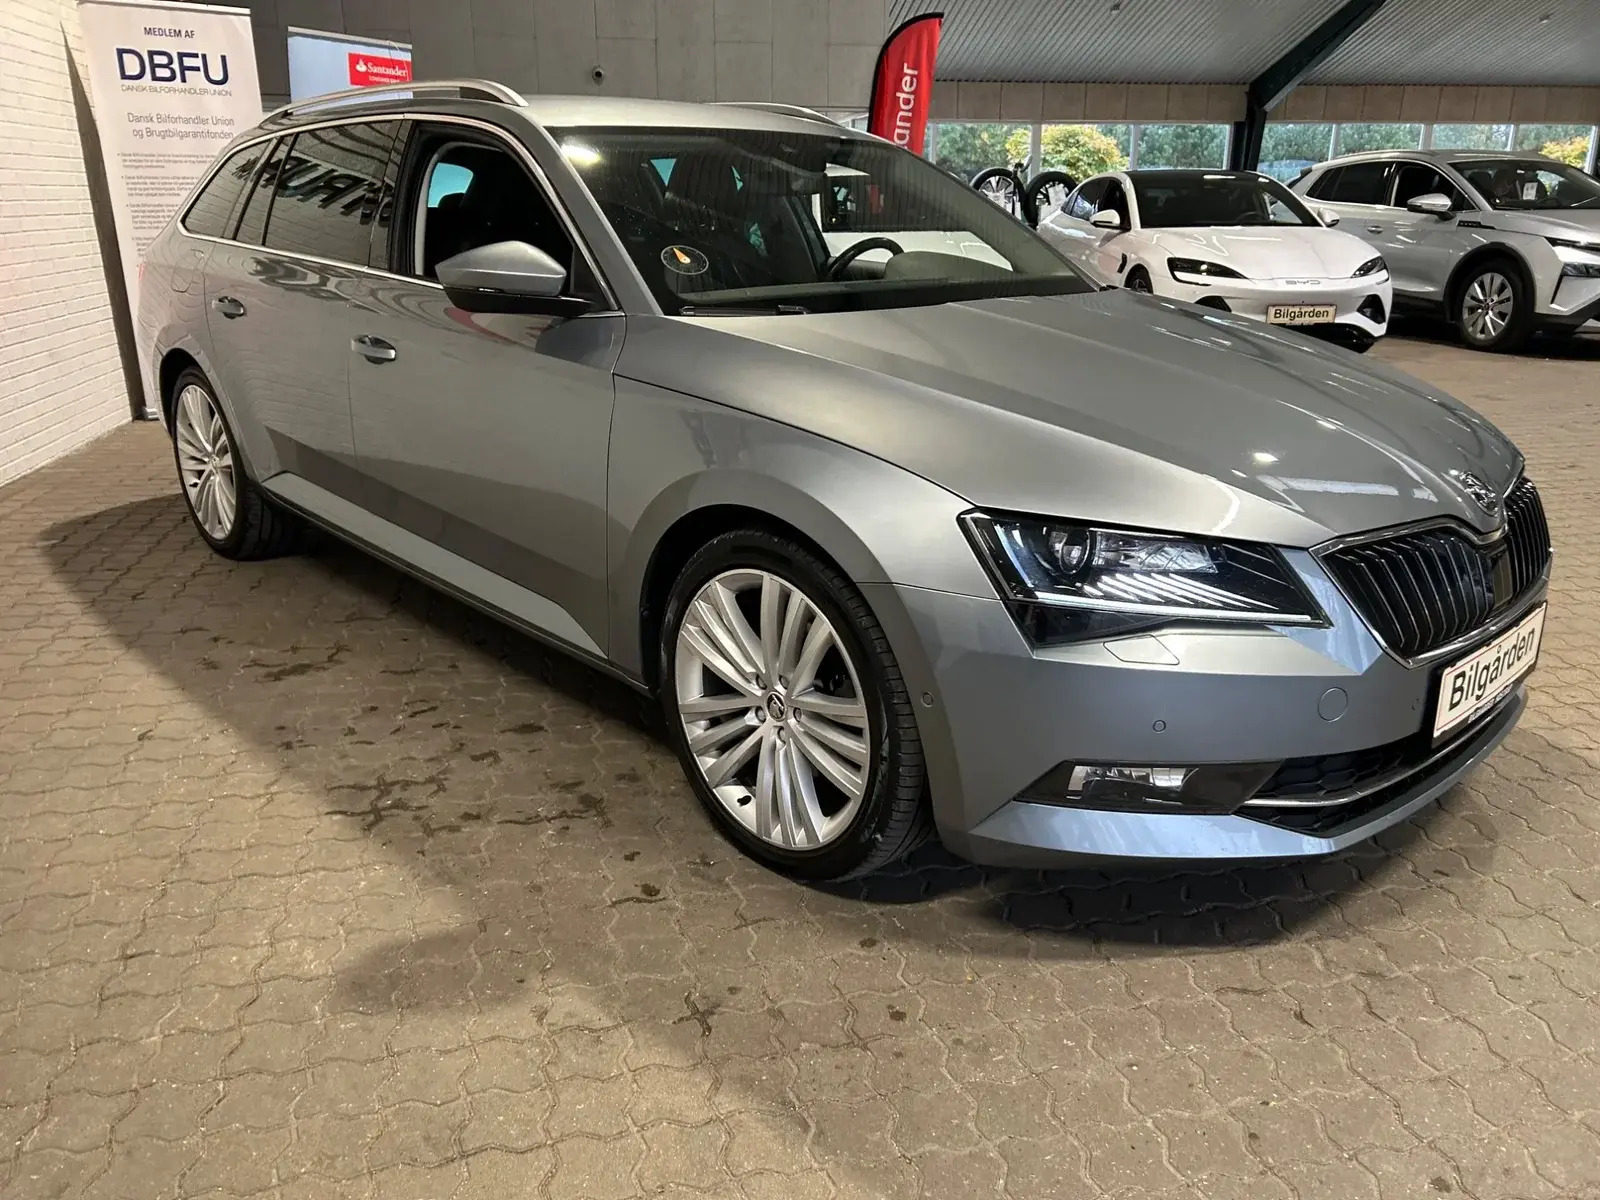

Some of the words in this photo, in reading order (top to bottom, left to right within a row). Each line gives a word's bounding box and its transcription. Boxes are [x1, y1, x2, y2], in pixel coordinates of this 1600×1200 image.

[143, 26, 182, 38] MEDLEM
[184, 29, 195, 39] AF
[115, 47, 229, 86] DBFU
[367, 61, 407, 77] Santander
[121, 84, 148, 93] DANSK
[148, 85, 209, 96] BILFORHANDLER
[209, 88, 233, 97] UNION
[893, 62, 919, 149] ander
[127, 112, 154, 124] Dansk
[156, 113, 209, 126] Bilforhandler
[211, 115, 235, 127] Union
[132, 128, 144, 139] og
[146, 127, 234, 140] Brugtbilgarantifonden
[1273, 307, 1329, 320] Bilgården
[1448, 627, 1536, 712] Bilgården
